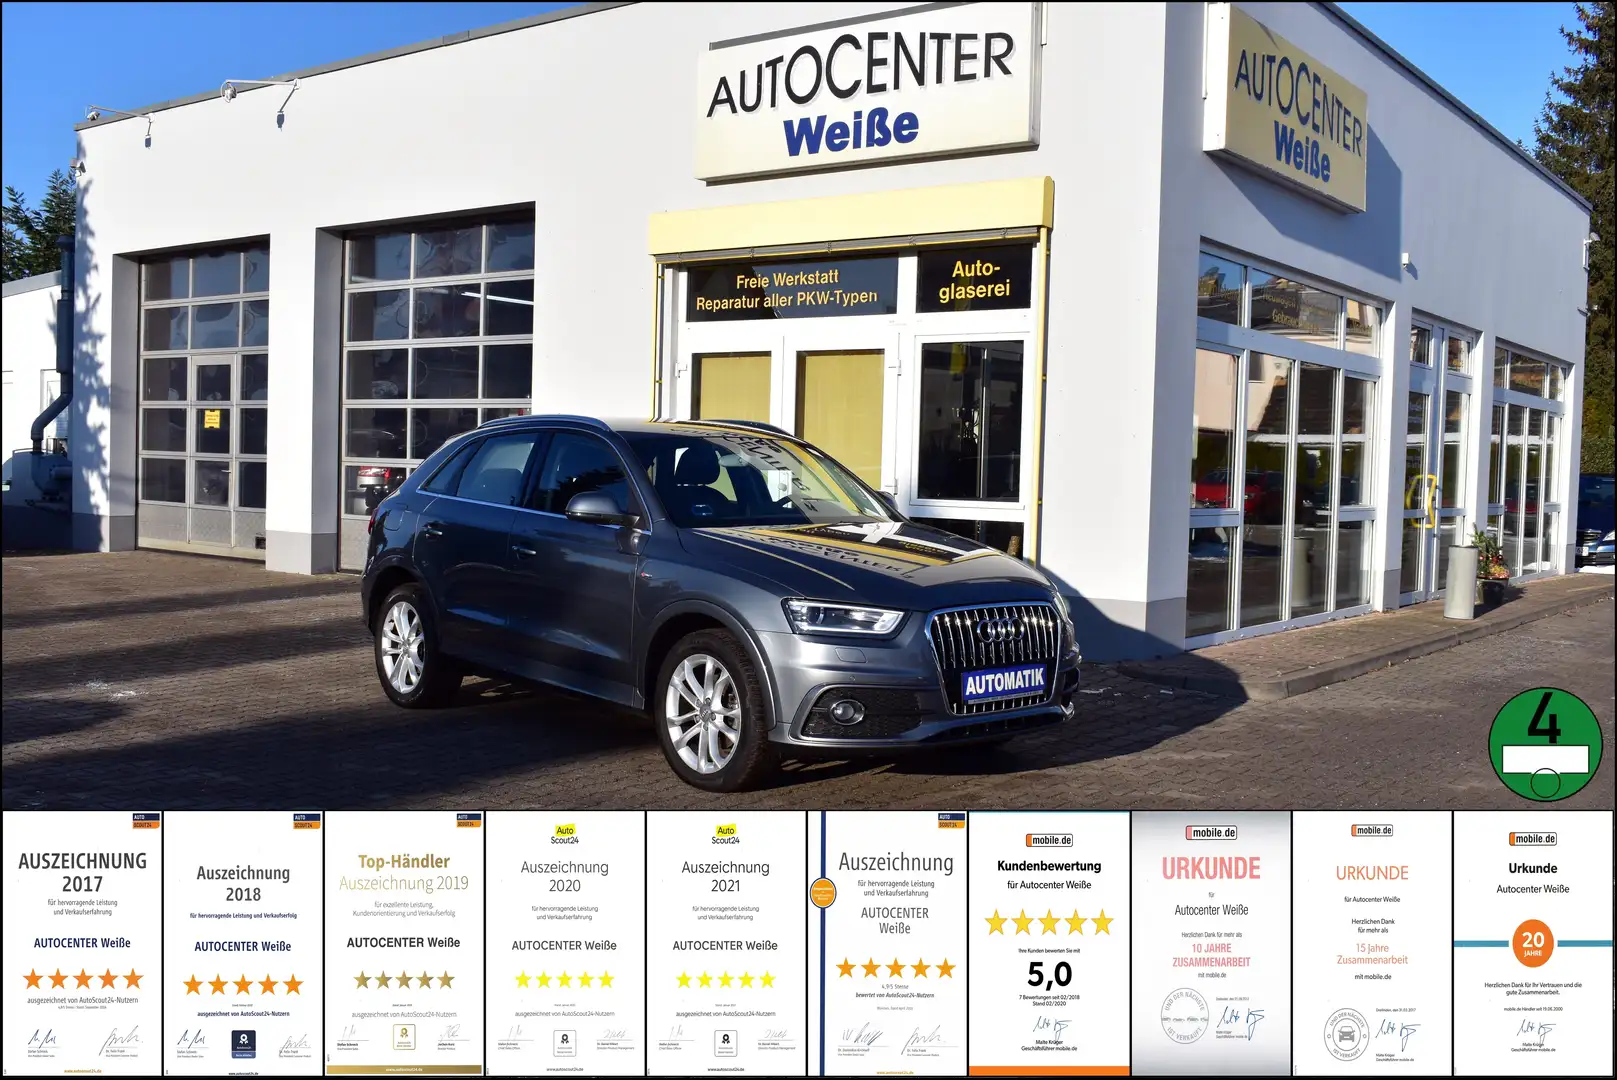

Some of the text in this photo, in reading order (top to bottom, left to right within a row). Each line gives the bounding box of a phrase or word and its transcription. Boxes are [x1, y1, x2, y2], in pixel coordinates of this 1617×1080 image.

[706, 32, 1014, 118] AUTOCENTER
[1234, 49, 1363, 157] AUTOCENTER
[783, 106, 919, 157] Weiße
[1273, 120, 1331, 182] Weiße
[736, 269, 840, 290] Freie Werkstatt
[952, 260, 1001, 279] Auto-
[696, 290, 878, 313] Reparatur aller PKW-Typen
[938, 279, 1011, 303] glaserei
[965, 667, 1045, 696] AUTOMATIK
